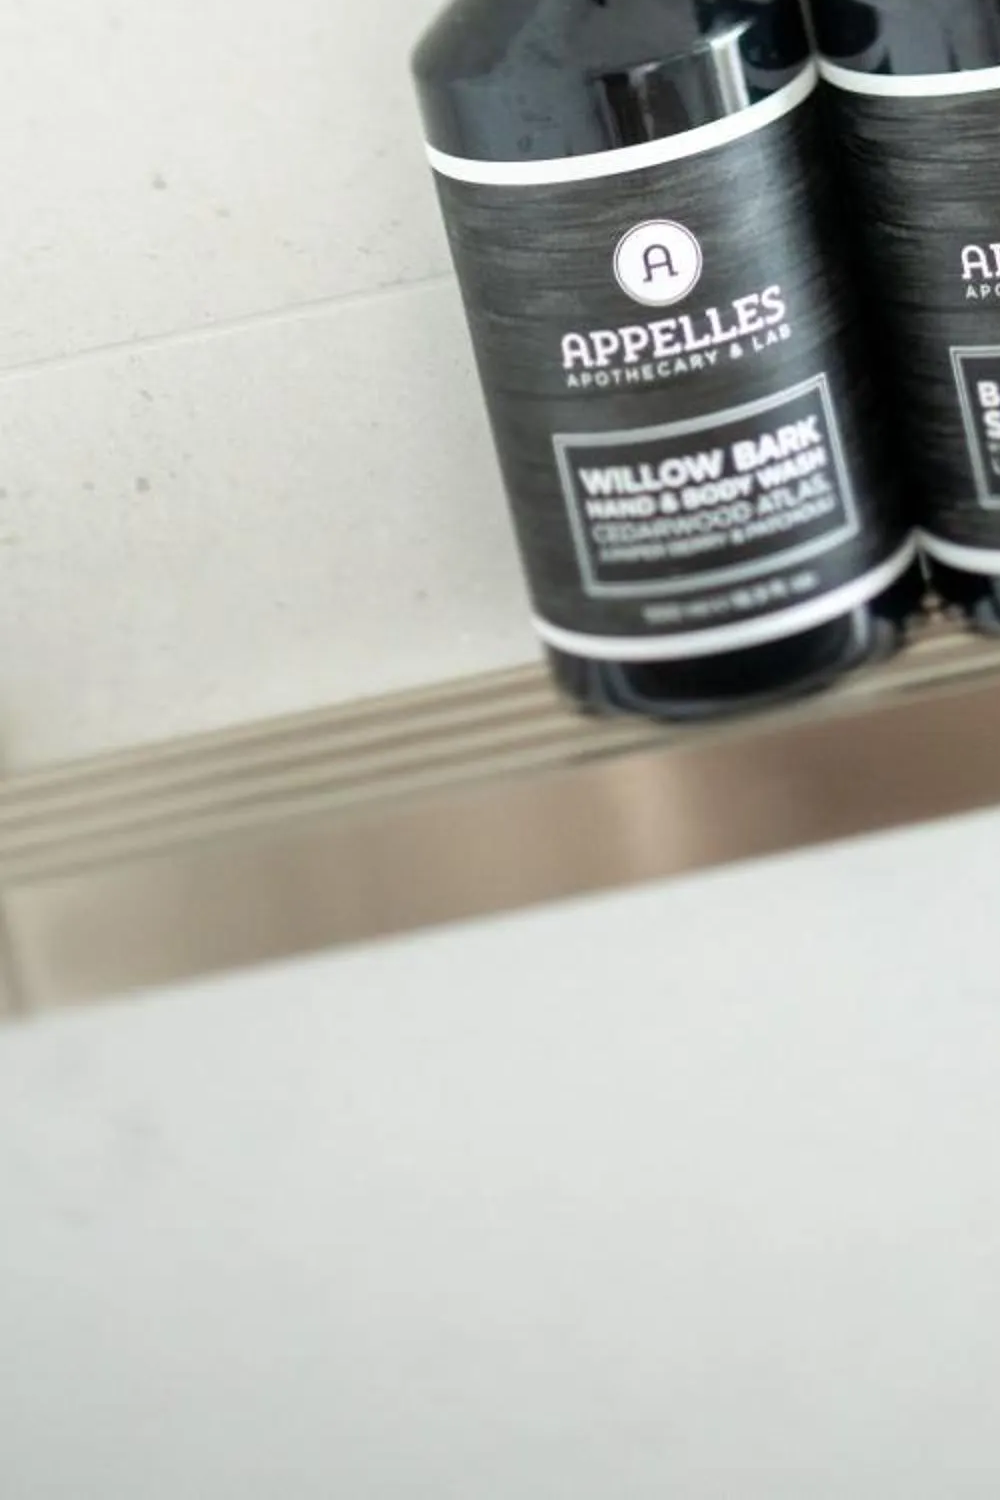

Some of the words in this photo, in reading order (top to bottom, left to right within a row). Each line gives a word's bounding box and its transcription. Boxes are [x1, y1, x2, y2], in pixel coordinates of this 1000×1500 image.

[643, 244, 678, 283] A
[560, 285, 787, 369] APPELLES
[567, 350, 719, 389] APOTHECARY
[729, 343, 744, 359] &
[752, 325, 792, 352] LAB
[579, 449, 724, 496] WILLOW
[732, 415, 822, 472] BARK
[586, 495, 655, 520] HAND
[660, 491, 679, 513] &
[681, 475, 752, 510] BODY
[756, 446, 826, 489] WASH
[592, 502, 753, 543] CEDARWOOD
